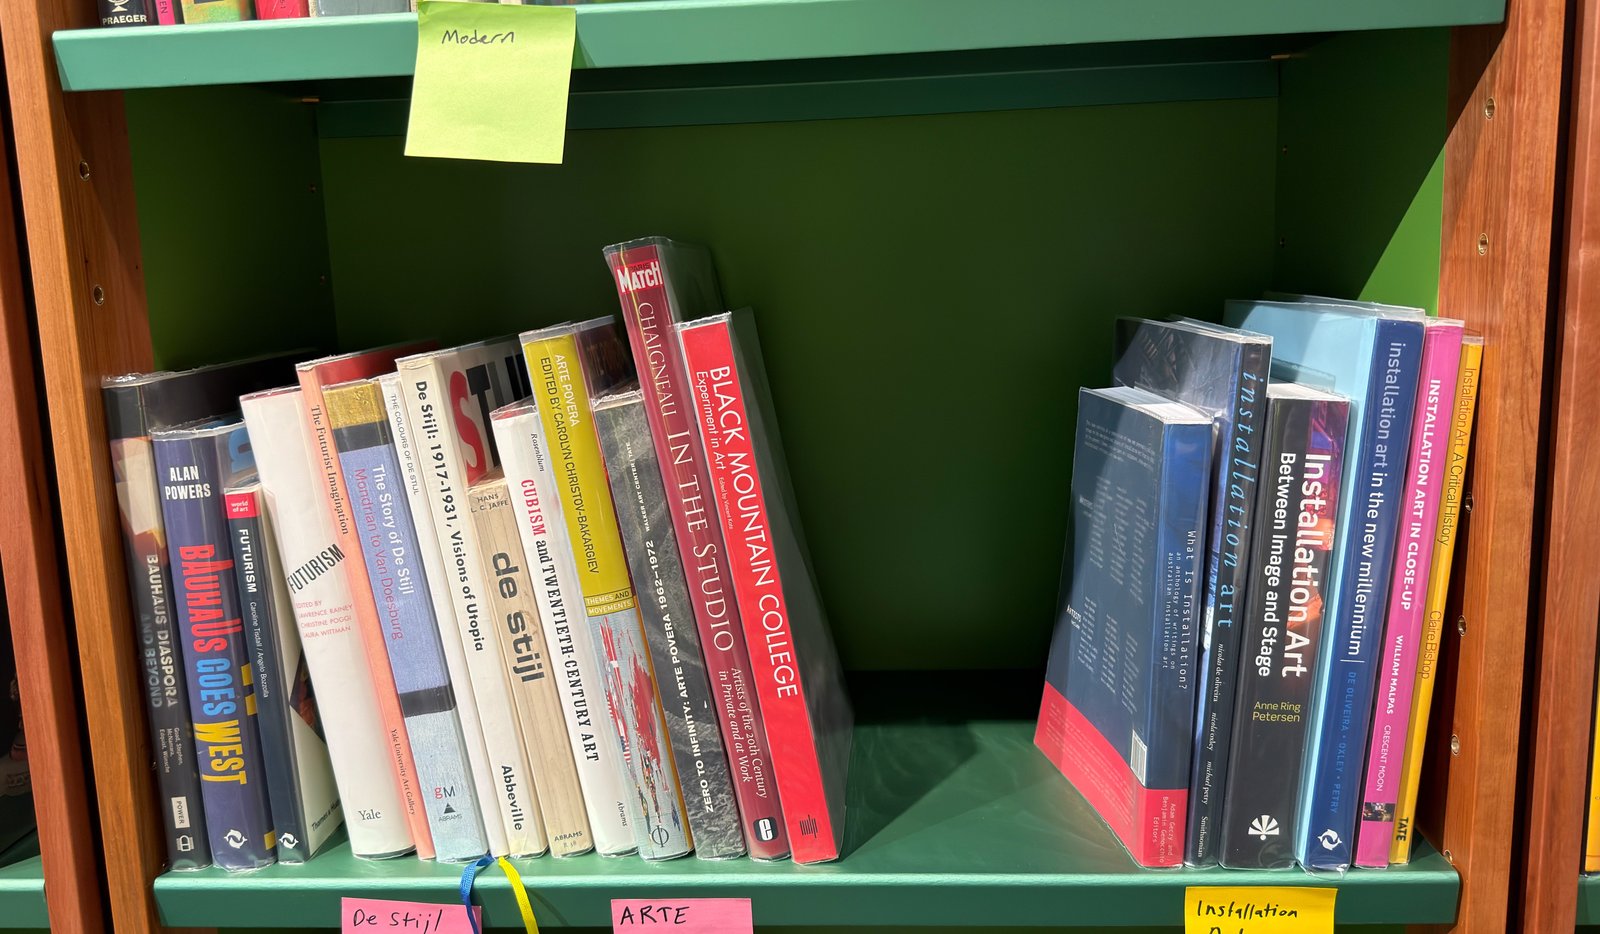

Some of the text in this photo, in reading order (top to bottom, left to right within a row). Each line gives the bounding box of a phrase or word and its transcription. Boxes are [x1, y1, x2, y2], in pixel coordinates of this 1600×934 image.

[102, 14, 147, 26] PRAEGER
[441, 29, 515, 45] Modern
[617, 260, 663, 293] MATCH
[554, 354, 581, 427] ARTE POVERA
[696, 371, 727, 470] Experiment in Art
[169, 465, 200, 482] ALAN
[311, 405, 349, 535] The Futurist Imagination
[391, 394, 420, 495] THE COLOURS OF DE STIJL
[531, 433, 545, 472] Rosenblum
[541, 357, 599, 574] EDITED BY CAROLYN CHRISTOV-BAKARGIEV
[638, 302, 734, 651] CHAIGNEAU IN THE STUDIO
[1437, 367, 1477, 547] Installation Art A Critical History
[165, 483, 212, 500] POWERS
[415, 380, 486, 652] De Stijl: 1917-1931, Visions of Utopia
[477, 493, 499, 503] HANS
[626, 442, 650, 532] WALKER ART CENTER TATE
[1217, 369, 1265, 629] installation art
[1348, 342, 1407, 656] installation art in the new millennium
[1400, 379, 1441, 611] INSTALLATION ART IN CLOSE-UP
[238, 529, 258, 594] FUTURISM
[354, 467, 404, 641] Mondrian to Van Doesburg
[373, 464, 415, 595] The Story of De Stijl
[710, 366, 798, 699] BLACK MOUNTAIN COLLEGE
[287, 543, 346, 595] FUTURISM
[586, 590, 630, 606] THEMES AND
[1255, 452, 1297, 677] Between Image and Stage
[1281, 453, 1332, 679] Installation Art
[146, 554, 178, 708] BAUHAUS DIASPORA
[250, 601, 259, 627] Caroline
[492, 552, 546, 683] de stijl
[521, 479, 600, 762] CUBISM and TWENTIETH-CENTURY ART
[587, 601, 632, 614] MOVEMENTS
[1163, 552, 1174, 653] australian installation
[1170, 566, 1181, 657] anthology writings
[1178, 530, 1197, 690] What Is Installation?
[141, 612, 163, 708] AND BEYOND
[179, 544, 248, 785] BAUHAUS GOES WEST
[662, 613, 681, 670] POVERA
[1386, 635, 1404, 715] WILLIAM MALPAS
[1420, 610, 1442, 680] Claire Bishop
[675, 670, 689, 698] ARTE
[1213, 677, 1222, 702] oliveira
[1252, 711, 1301, 723] Petersen
[1254, 701, 1301, 713] Anne Ring
[682, 698, 701, 759] INFINITY:
[719, 670, 751, 783] in Private and at Work
[731, 667, 767, 799] Artists of the 20th Century
[1330, 671, 1357, 814] DE OLIVEIRA OXLEY PETRY
[1375, 724, 1392, 792] CRESCENT MOON
[391, 728, 416, 816] Yale University Art Gallery
[501, 765, 525, 831] Abbeville
[695, 761, 705, 777] TO
[699, 778, 714, 813] ZERO
[176, 800, 185, 825] POWER
[358, 808, 382, 822] Yale
[438, 813, 463, 822] ABRAMS
[554, 830, 584, 842] ABRAMS
[617, 800, 628, 827] Abrams
[1152, 816, 1160, 843] Editors
[1197, 816, 1208, 858] Smithsonian
[1396, 816, 1409, 843] TATE
[353, 908, 443, 934] De Stijl
[620, 905, 690, 925] ARTE
[1197, 900, 1298, 920] Installation
